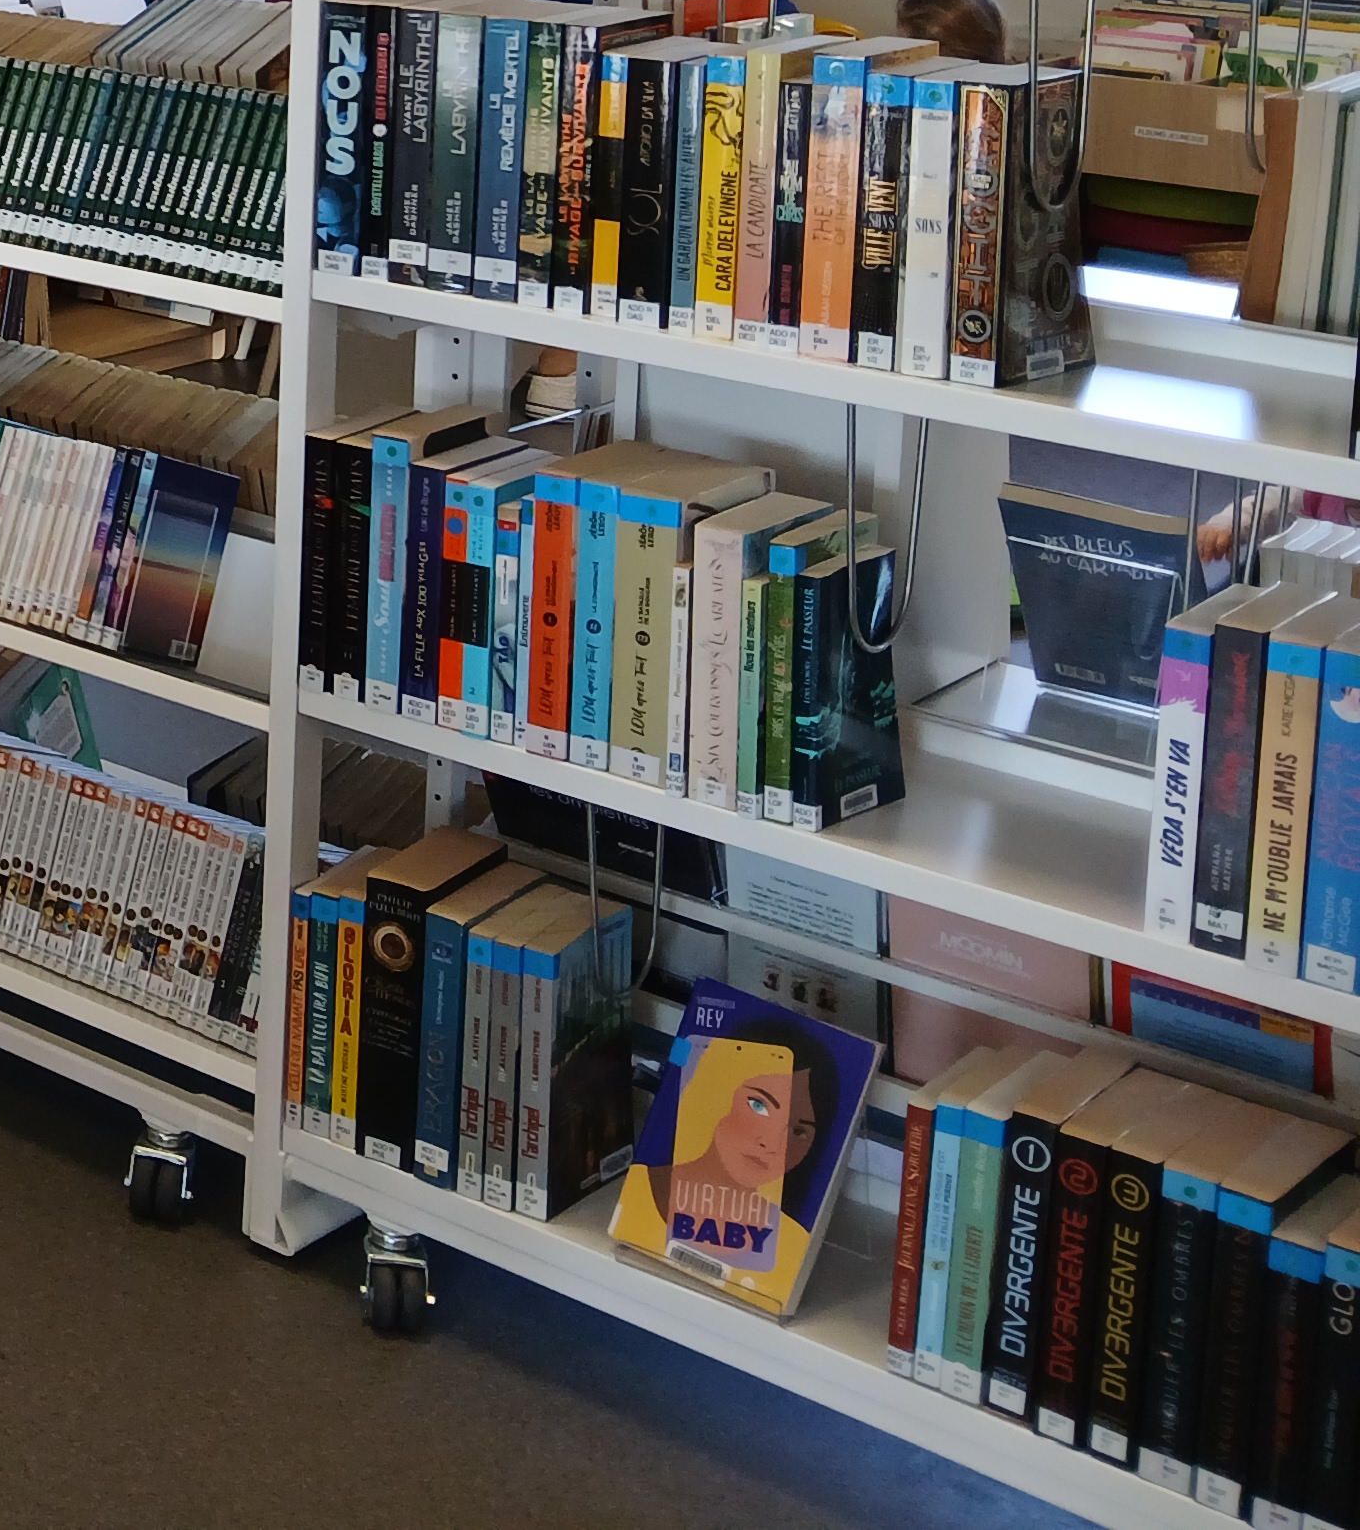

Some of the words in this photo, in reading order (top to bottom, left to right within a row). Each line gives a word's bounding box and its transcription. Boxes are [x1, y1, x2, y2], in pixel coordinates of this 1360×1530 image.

[412, 14, 432, 143] LABYRINTHE
[505, 29, 520, 100] MORTEL
[325, 30, 362, 176] NOUS
[490, 93, 501, 109] LE
[499, 103, 517, 172] REMÈDE
[746, 160, 768, 238] CANDIDATE
[780, 175, 802, 192] NOM
[627, 183, 663, 236] SOL
[717, 171, 739, 252] DELEVINGNE
[776, 205, 804, 223] CHRIS
[812, 205, 832, 243] THE
[745, 242, 764, 260] LA
[715, 255, 734, 292] CARA
[1073, 535, 1135, 558] BLEUS
[802, 588, 814, 636] PASSEUR
[414, 633, 426, 662] FILLE
[800, 637, 812, 651] LE
[539, 688, 555, 716] LOU
[580, 696, 596, 724] LOU
[631, 708, 646, 736] LOU
[1169, 738, 1191, 765] VA
[1164, 767, 1188, 815] S'EN
[1270, 752, 1298, 816] JAMAIS
[1160, 819, 1184, 868] VÉDA
[1265, 823, 1293, 903] M'OUBLIE
[1263, 911, 1286, 933] NE
[696, 1007, 724, 1029] REY
[676, 1180, 773, 1227] VIRTUAL
[672, 1212, 773, 1254] BABY
